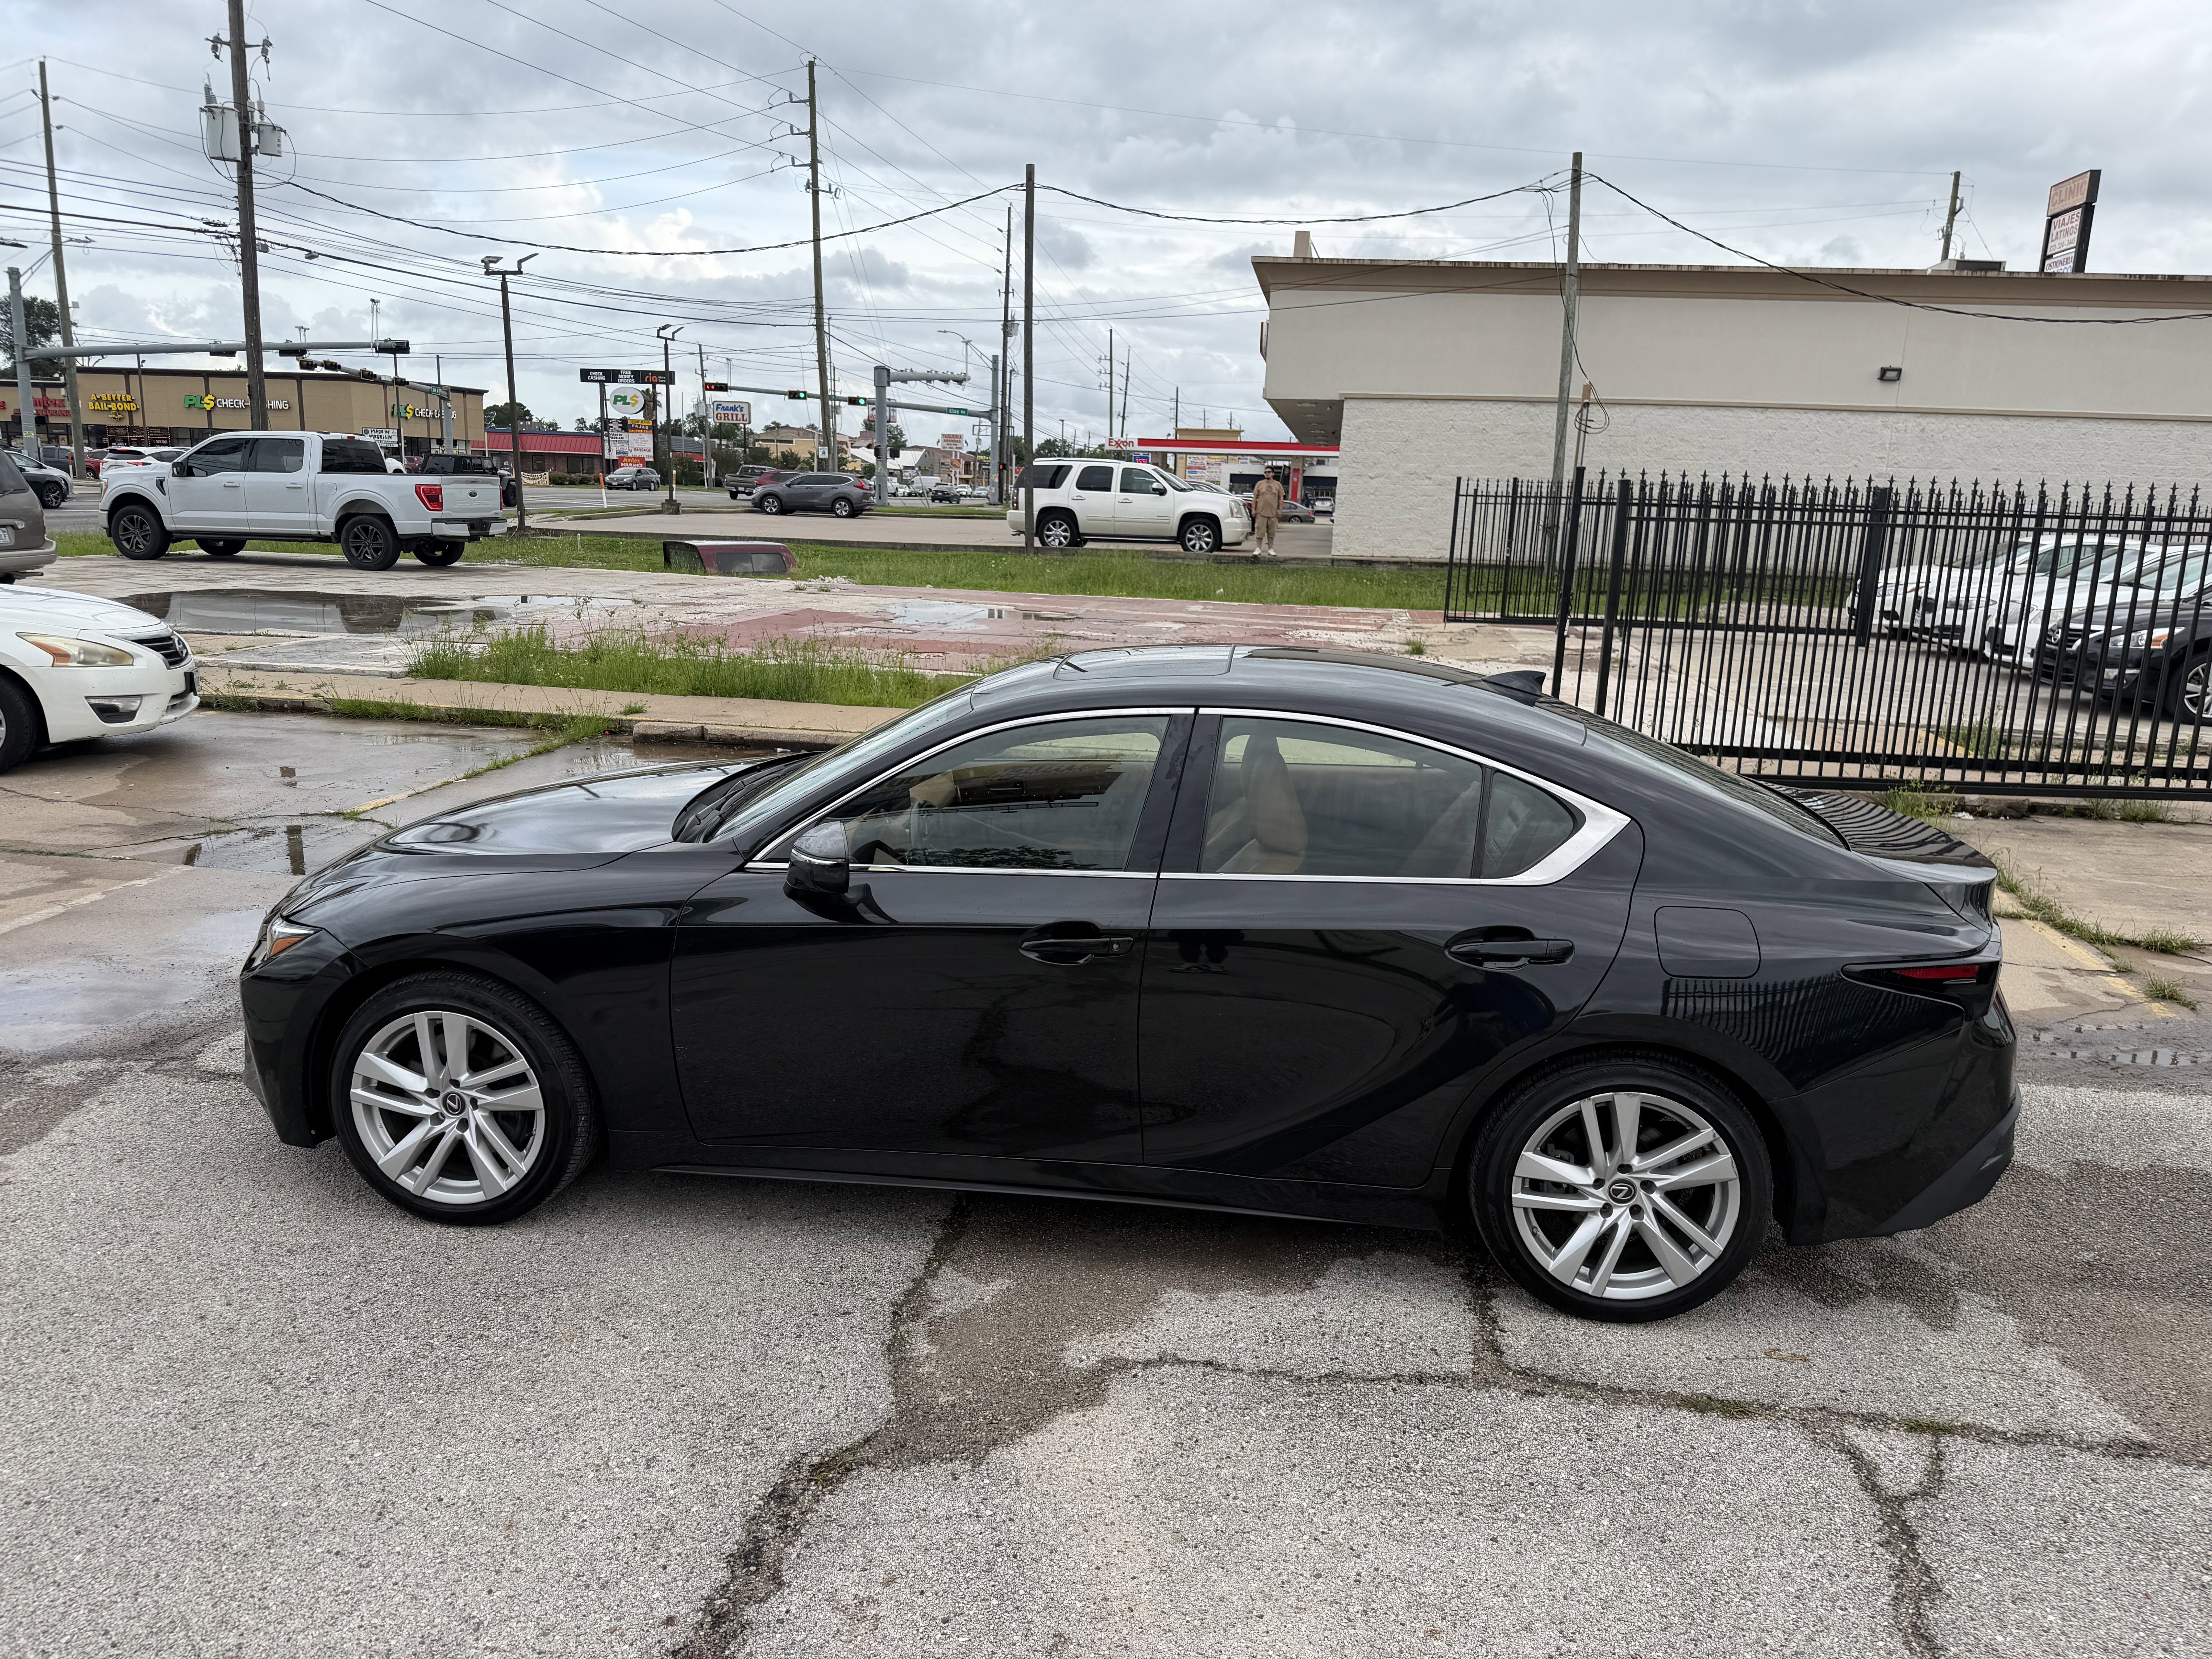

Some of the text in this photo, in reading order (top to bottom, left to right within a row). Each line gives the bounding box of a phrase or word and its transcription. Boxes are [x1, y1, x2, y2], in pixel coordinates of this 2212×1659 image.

[2052, 180, 2087, 207] CLINIC
[2054, 211, 2080, 230] VIAJES
[2051, 224, 2078, 242] LATINOS
[645, 372, 658, 382] ria
[88, 402, 137, 411] BAIL BOND
[184, 394, 215, 410] PL$
[216, 398, 245, 409] CHECK
[613, 394, 639, 407] PL$
[415, 408, 433, 418] CHECK
[716, 404, 744, 412] Frank's
[715, 412, 747, 422] GRILL
[1109, 438, 1134, 450] Exxon
